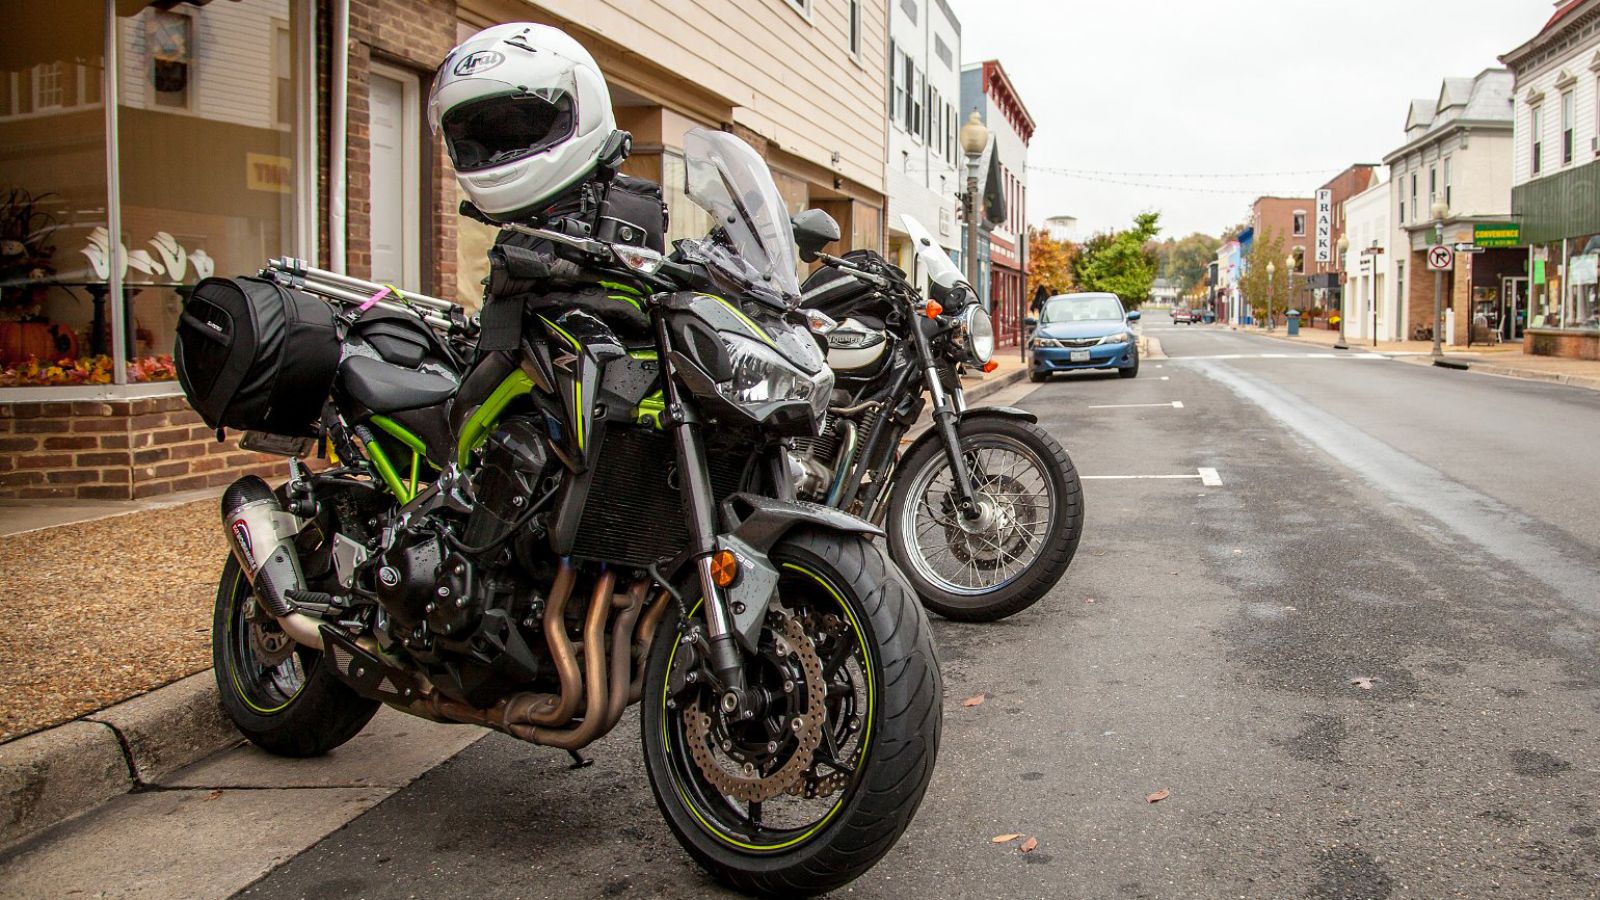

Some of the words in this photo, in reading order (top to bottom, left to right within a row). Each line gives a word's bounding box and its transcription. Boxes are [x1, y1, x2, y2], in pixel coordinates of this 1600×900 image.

[459, 53, 498, 71] Arai
[1318, 191, 1329, 260] FRANKS
[1475, 229, 1519, 239] CONVENIENCE
